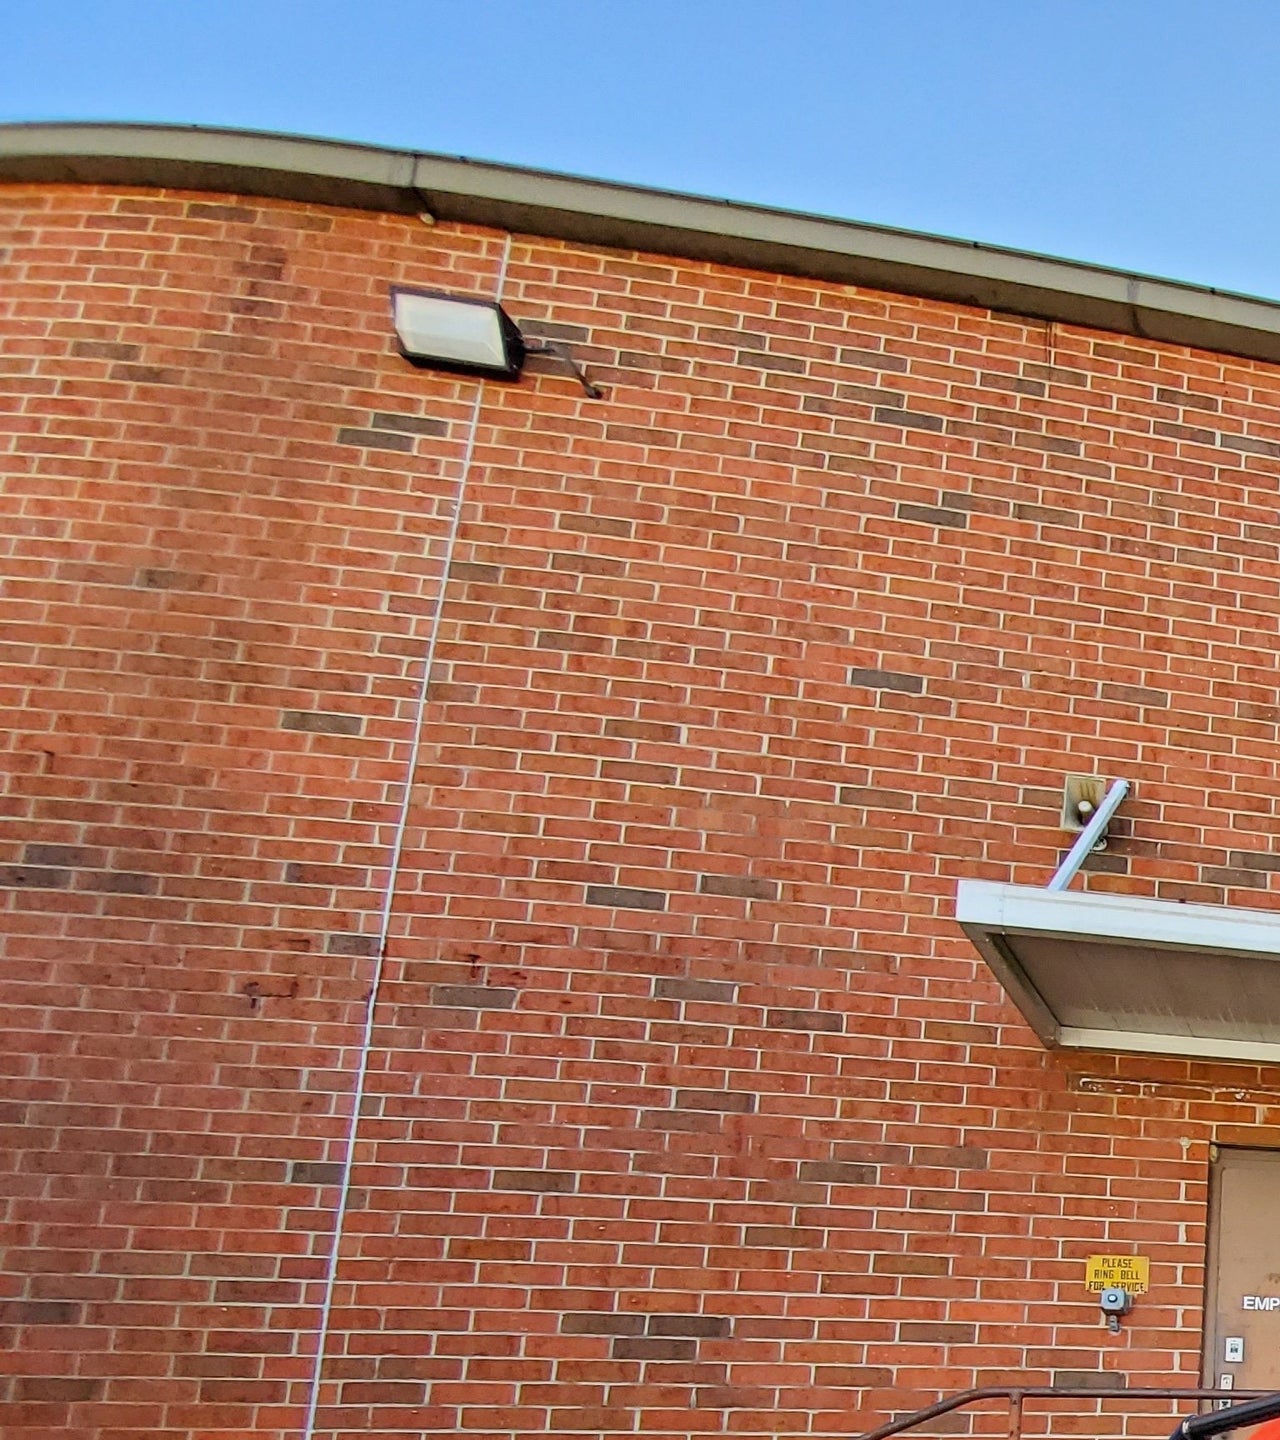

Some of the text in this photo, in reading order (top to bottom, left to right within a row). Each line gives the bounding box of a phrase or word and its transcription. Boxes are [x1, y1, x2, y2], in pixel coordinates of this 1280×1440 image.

[1102, 1257, 1133, 1269] PLEASE
[1094, 1269, 1141, 1280] RING BELL
[1088, 1280, 1105, 1291] FOR
